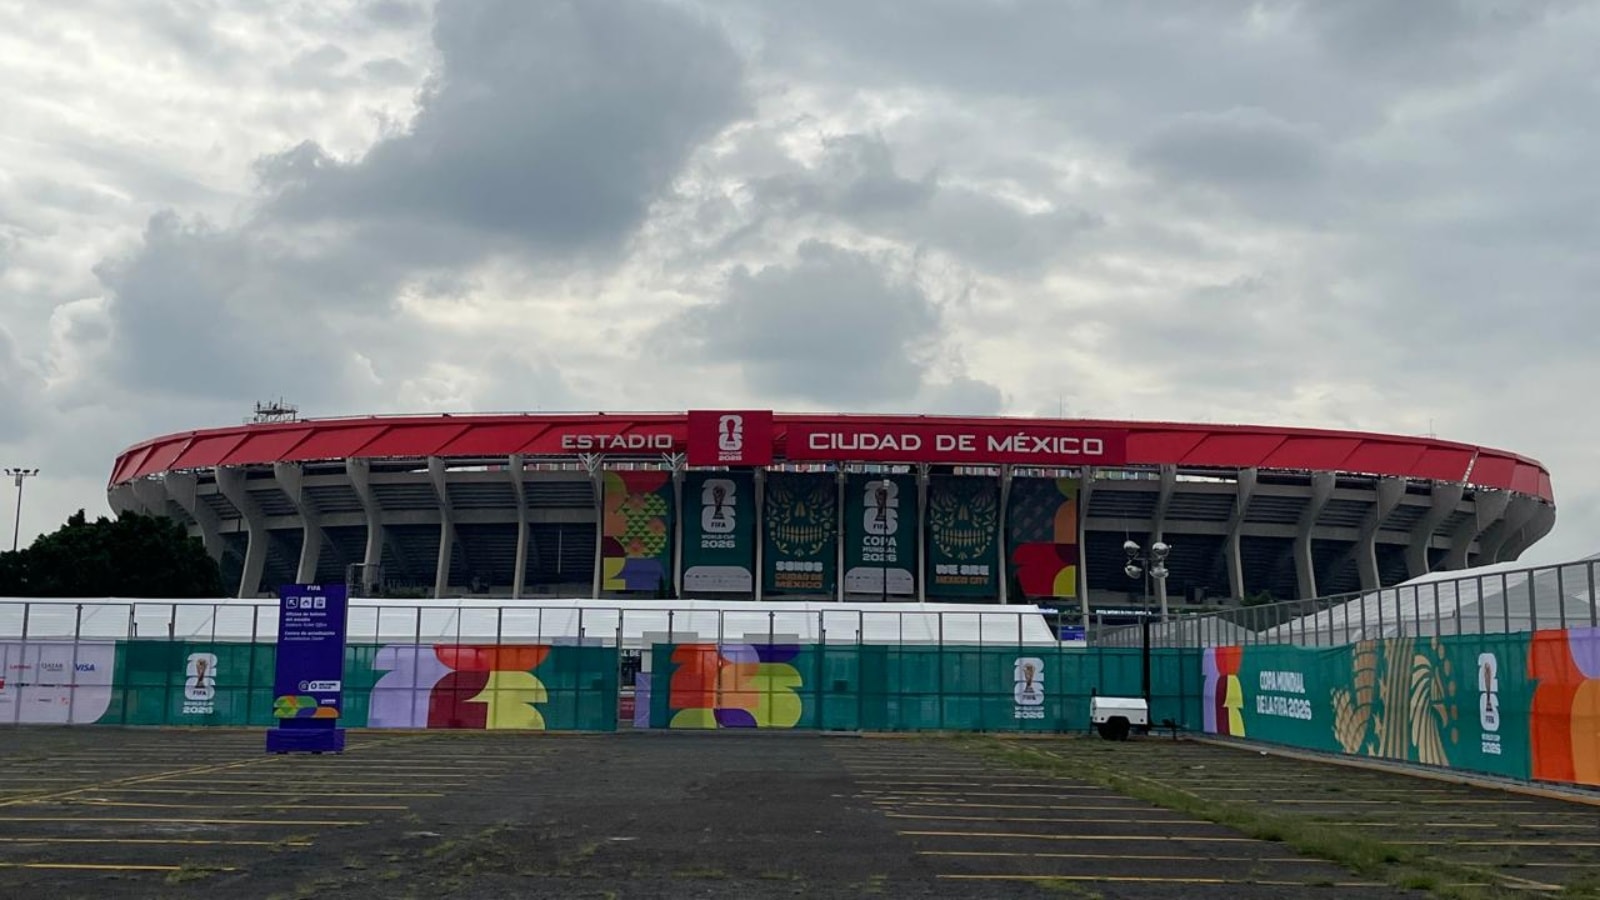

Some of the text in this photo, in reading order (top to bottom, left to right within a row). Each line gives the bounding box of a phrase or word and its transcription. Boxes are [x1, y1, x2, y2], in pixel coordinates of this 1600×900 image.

[561, 433, 673, 449] ESTADIO
[809, 431, 1104, 455] CIUDAD DE MÉXICO
[701, 540, 736, 549] 2026
[863, 536, 898, 546] COPA
[862, 546, 897, 554] MUNDAL
[862, 553, 897, 562] 2026
[75, 663, 96, 671] VISA
[1259, 670, 1306, 694] COPA MUNDIAL
[182, 705, 214, 714] 2026
[1256, 694, 1312, 721] DE LA FIFA 2026
[1014, 711, 1045, 719] 2026
[1481, 741, 1502, 755] 2026
